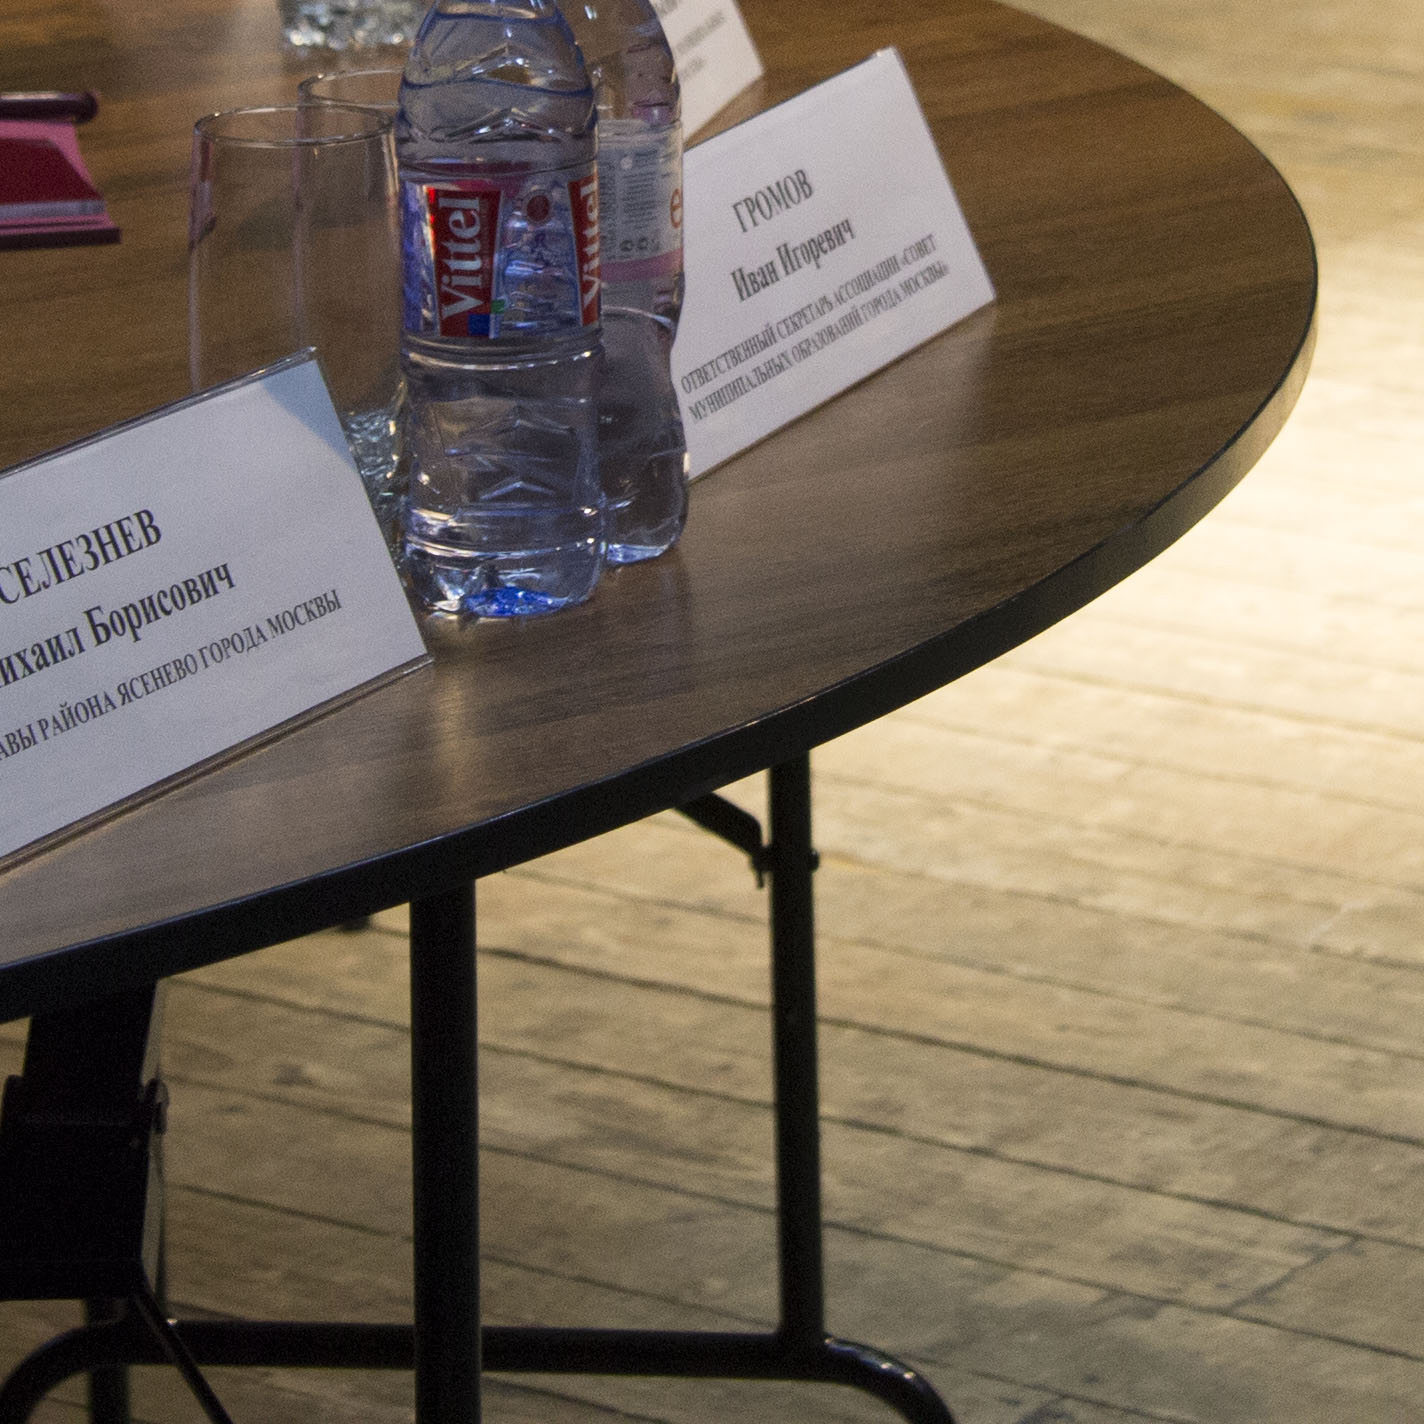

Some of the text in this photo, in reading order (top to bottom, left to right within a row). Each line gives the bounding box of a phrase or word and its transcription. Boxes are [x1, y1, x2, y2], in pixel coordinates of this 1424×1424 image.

[438, 196, 485, 320] Vittel
[730, 217, 857, 303] Иван Игоревич
[732, 168, 814, 233] ГРОМОВ
[680, 322, 779, 395] ОТВЕТСТВЕННЫЙ
[776, 293, 835, 340] СЕКРЕТАРЬ
[833, 253, 902, 307] АССОЦИАЦИИ
[688, 351, 794, 425] МУНИЦИПАЛЬНЫХ
[791, 306, 865, 365] ОБРАЗОВАНИЙ
[860, 285, 904, 326] ГОРОДА
[36, 690, 117, 741] РАЙОНА
[117, 652, 198, 707] ЯСЕНЕВО
[197, 623, 269, 670] ГОРОДА
[266, 588, 343, 639] МОСКВЫ
[82, 562, 236, 648] Борисович
